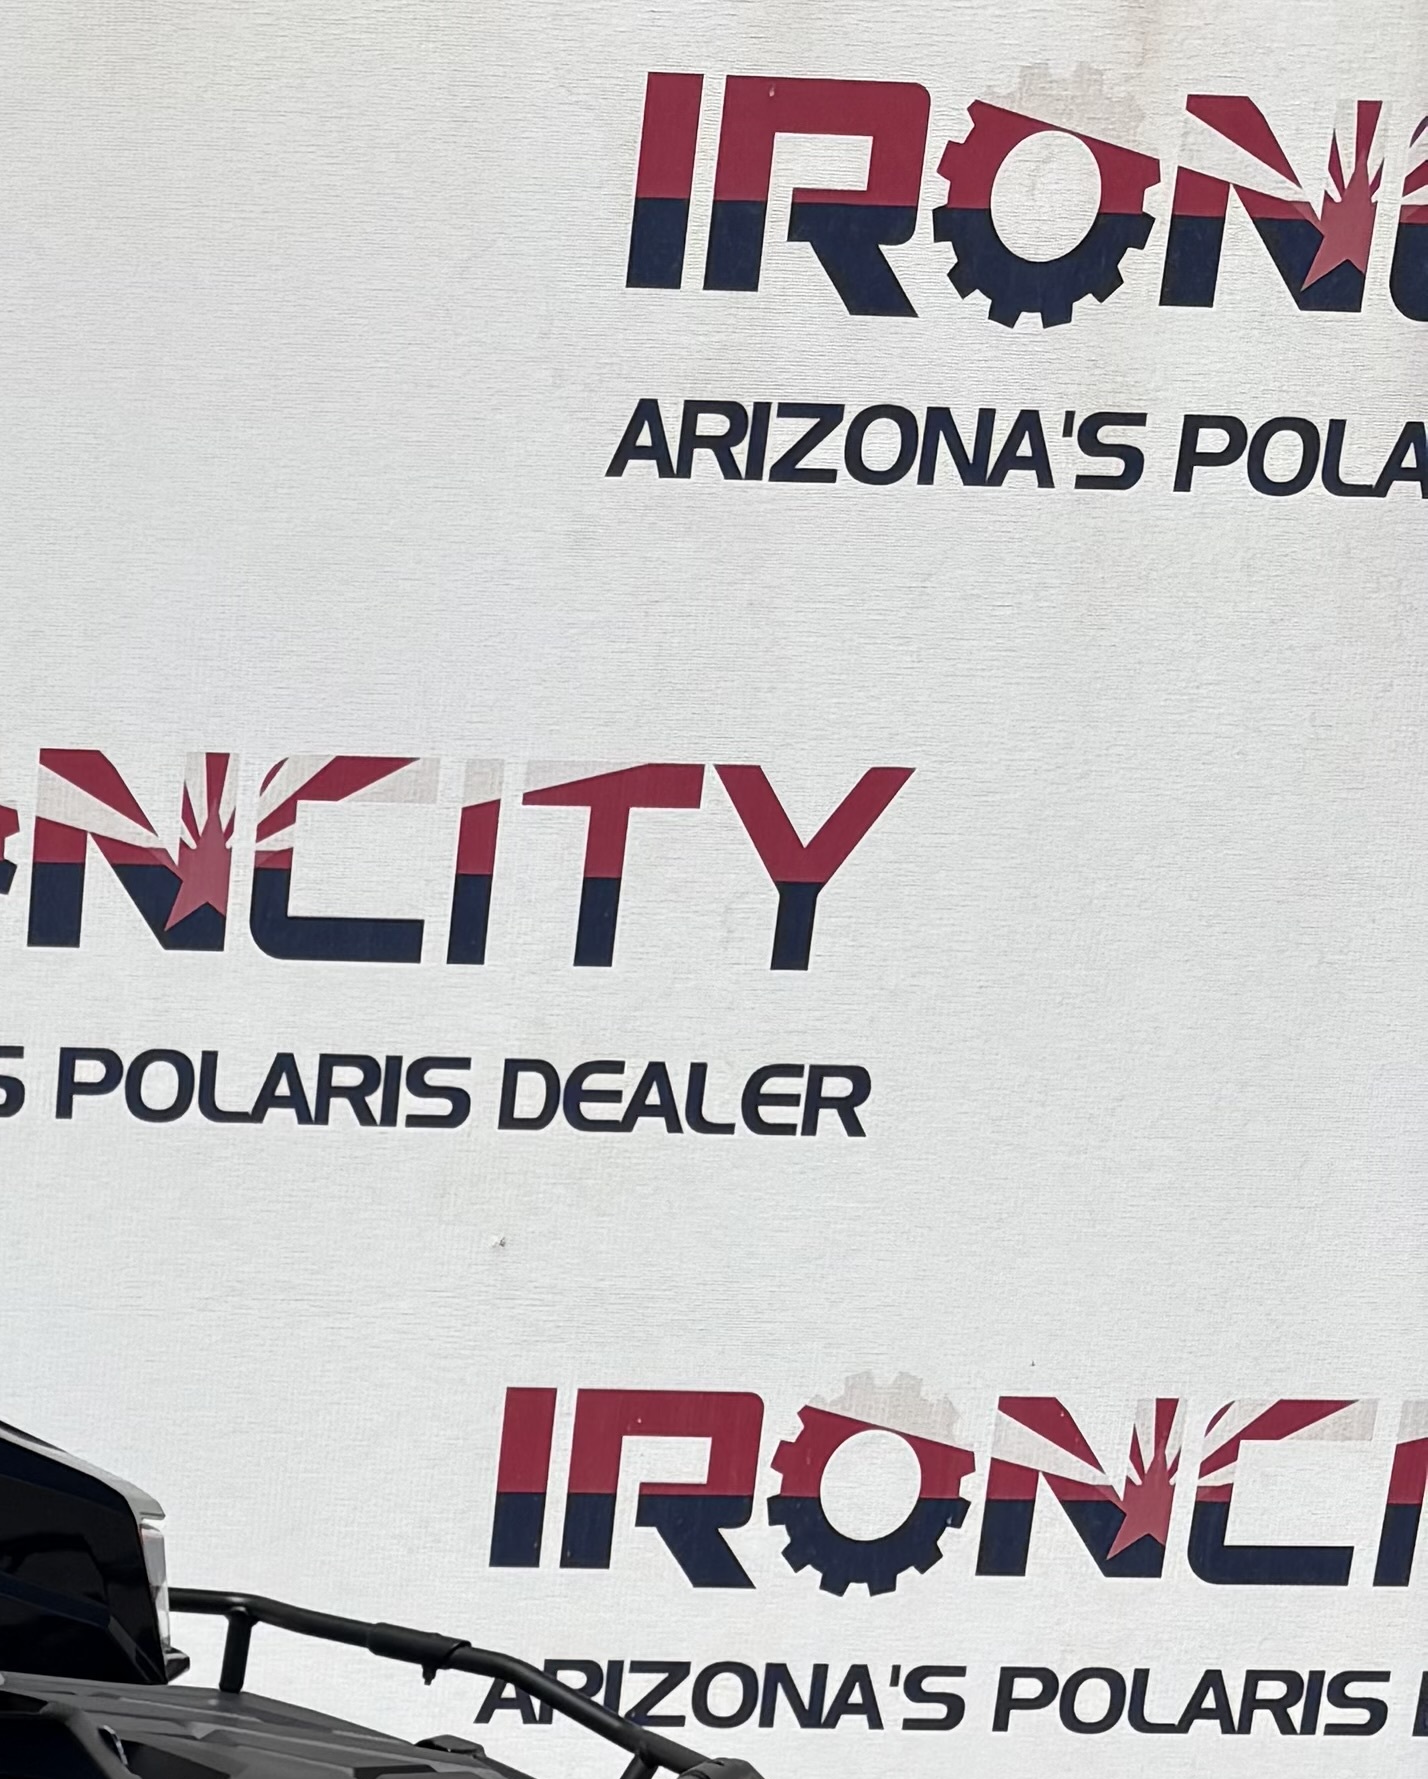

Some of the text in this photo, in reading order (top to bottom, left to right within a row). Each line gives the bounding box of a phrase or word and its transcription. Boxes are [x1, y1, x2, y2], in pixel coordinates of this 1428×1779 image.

[605, 398, 1147, 490] ARIZONA'S
[56, 1047, 471, 1128] POLARIS
[498, 1058, 871, 1137] DEALER
[992, 1667, 1391, 1736] POLARIS
